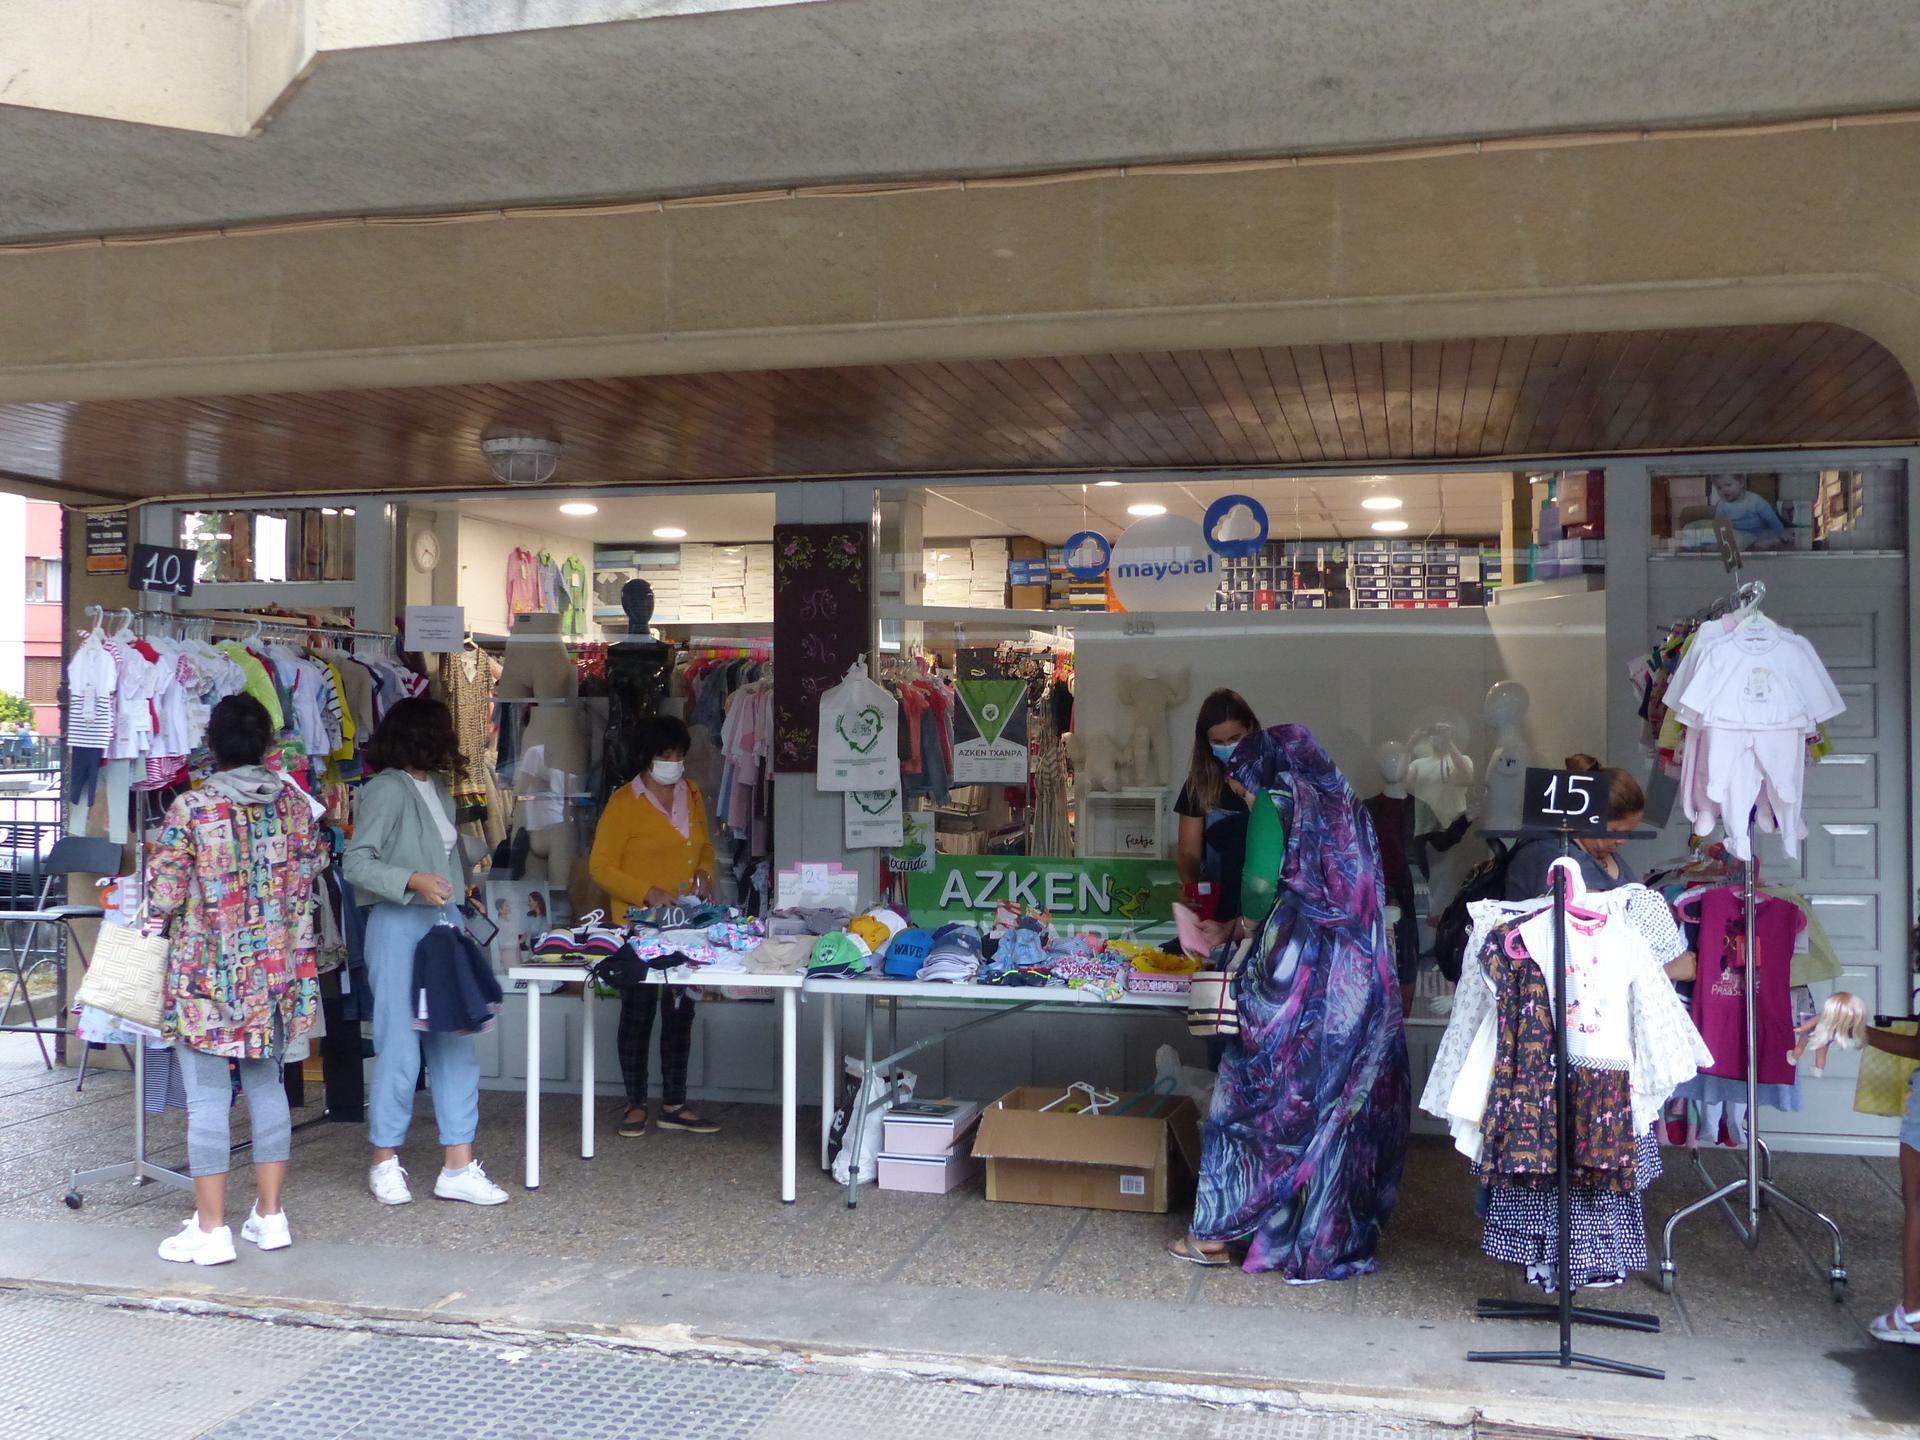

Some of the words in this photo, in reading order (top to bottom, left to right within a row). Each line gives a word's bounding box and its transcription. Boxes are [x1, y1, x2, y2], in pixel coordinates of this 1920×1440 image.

[1117, 554, 1213, 581] mayoral
[958, 749, 987, 757] AZKEN
[989, 749, 1023, 758] TXANPA
[938, 868, 1112, 913] AZKEN
[894, 943, 924, 959] WAVE
